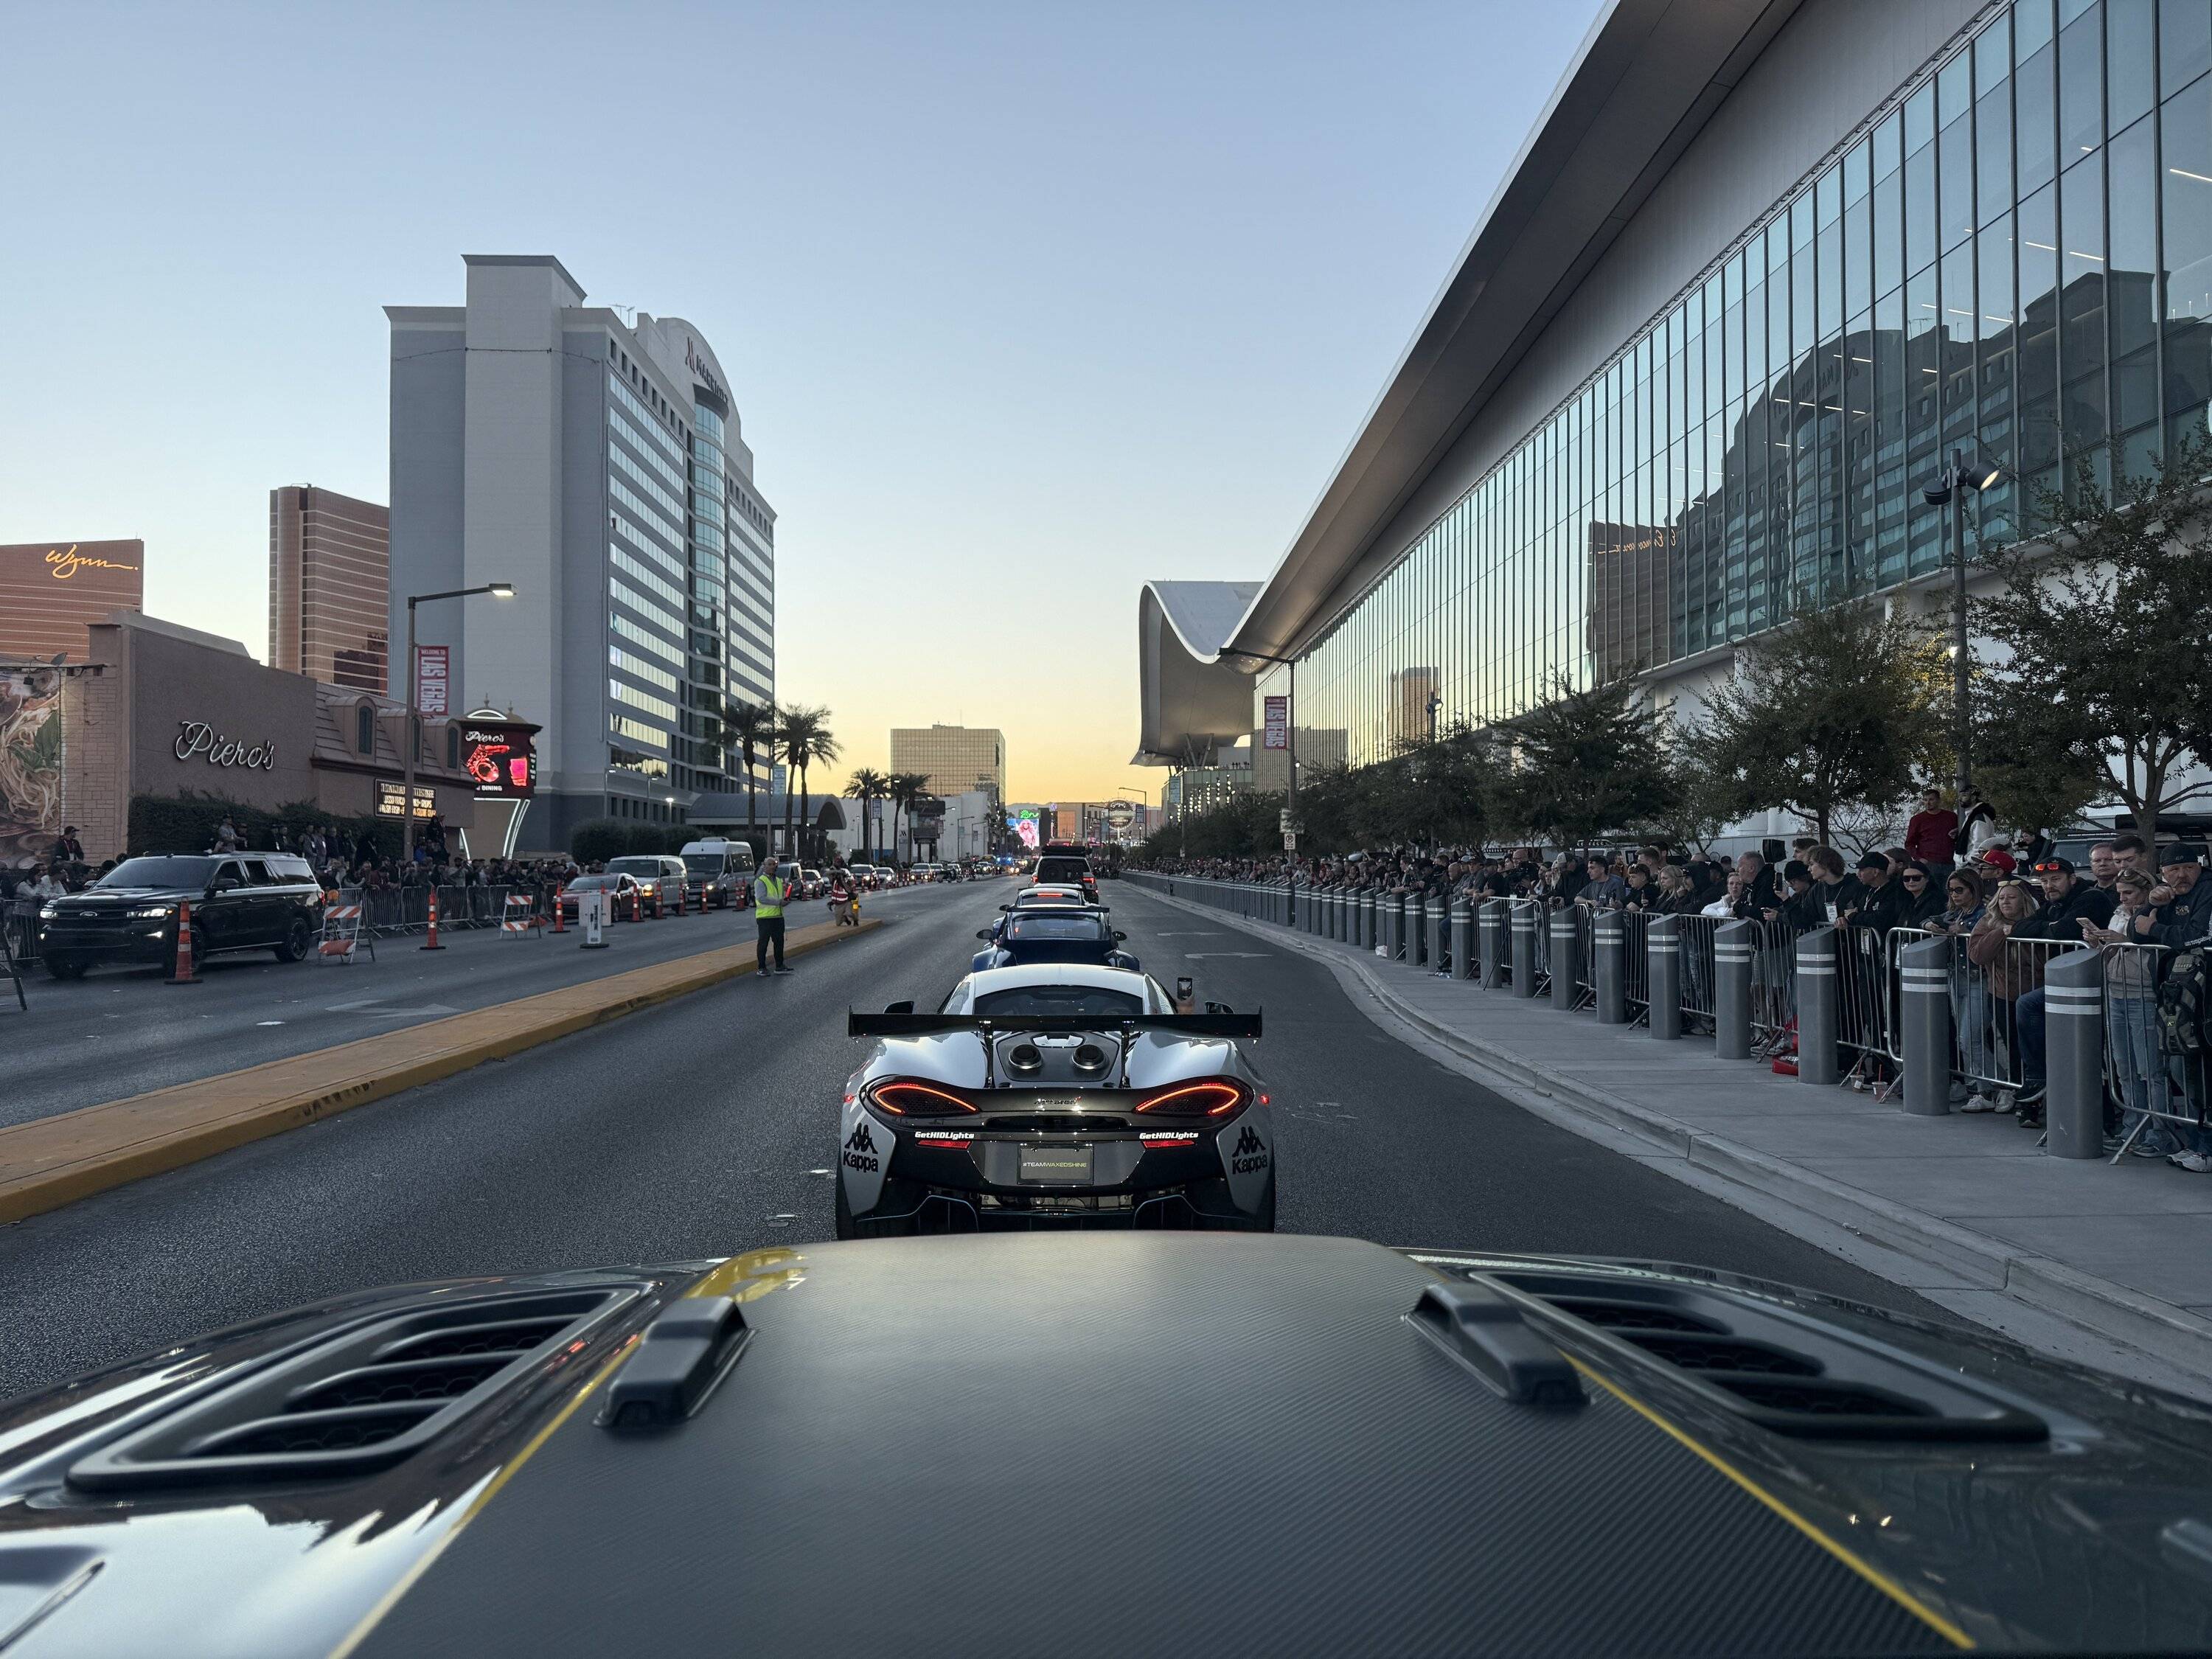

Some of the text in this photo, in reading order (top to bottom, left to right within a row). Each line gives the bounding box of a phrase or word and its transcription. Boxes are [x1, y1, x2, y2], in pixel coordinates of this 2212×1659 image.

[420, 656, 446, 677] LAS
[420, 679, 446, 712] VEGAS
[1266, 703, 1285, 720] LAS
[465, 731, 504, 742] Piero's
[1266, 721, 1285, 747] VEGAS
[175, 720, 274, 770] Piero's
[914, 1131, 975, 1141] GetHIDLights
[1139, 1131, 1199, 1140] GetHIDLights
[843, 1151, 879, 1173] Kappa
[1232, 1154, 1268, 1175] Kappa
